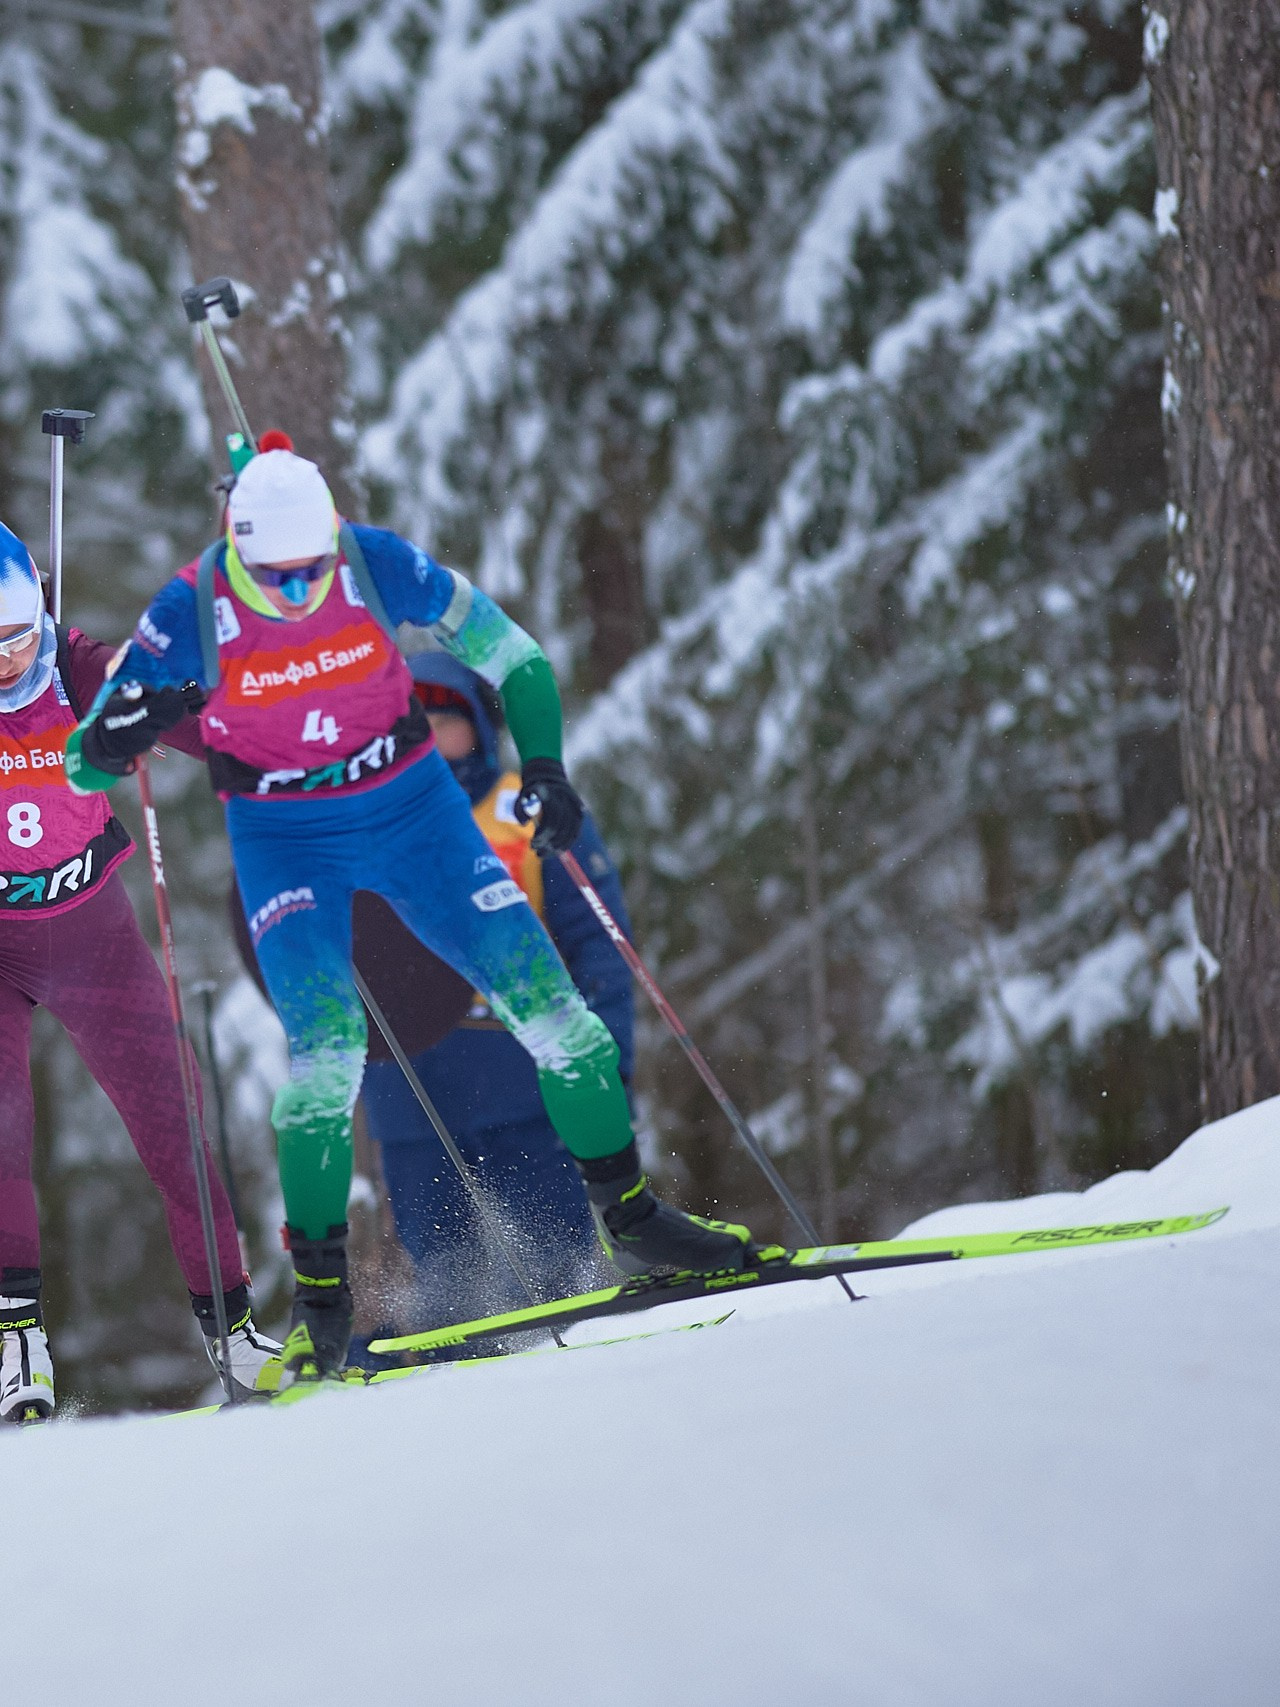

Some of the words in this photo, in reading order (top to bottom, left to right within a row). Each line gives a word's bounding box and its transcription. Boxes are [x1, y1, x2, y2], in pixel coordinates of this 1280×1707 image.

[242, 661, 318, 695] Альфа
[318, 641, 375, 673] Банк
[301, 709, 344, 746] 4
[29, 748, 67, 770] Бан
[6, 801, 44, 849] 8
[1011, 1219, 1164, 1246] FISCHER
